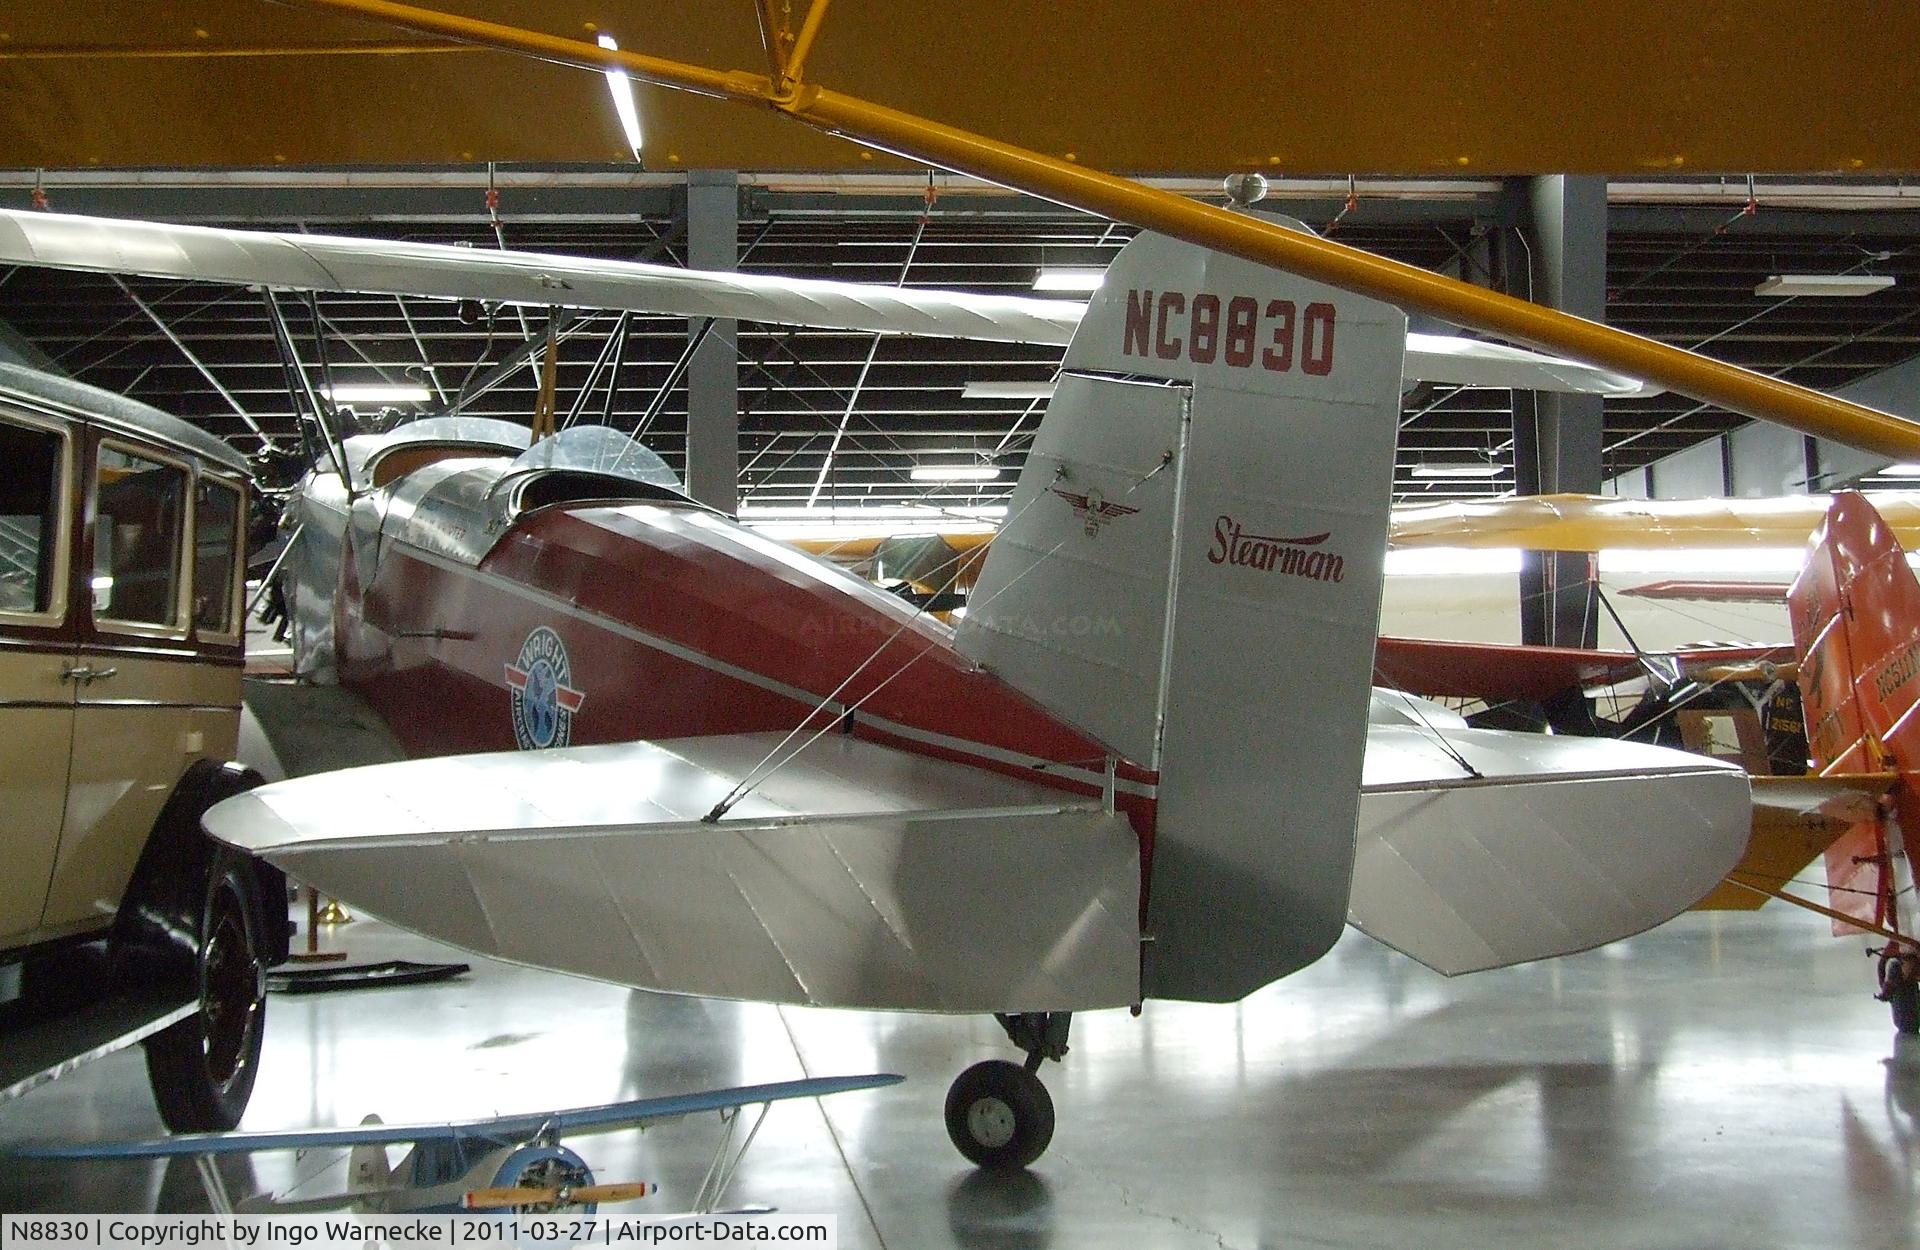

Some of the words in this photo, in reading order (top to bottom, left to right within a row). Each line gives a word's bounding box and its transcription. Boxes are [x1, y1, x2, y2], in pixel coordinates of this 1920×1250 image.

[1123, 289, 1336, 377] NC8830
[1207, 515, 1345, 583] Stearman
[522, 634, 568, 681] WRIGHT
